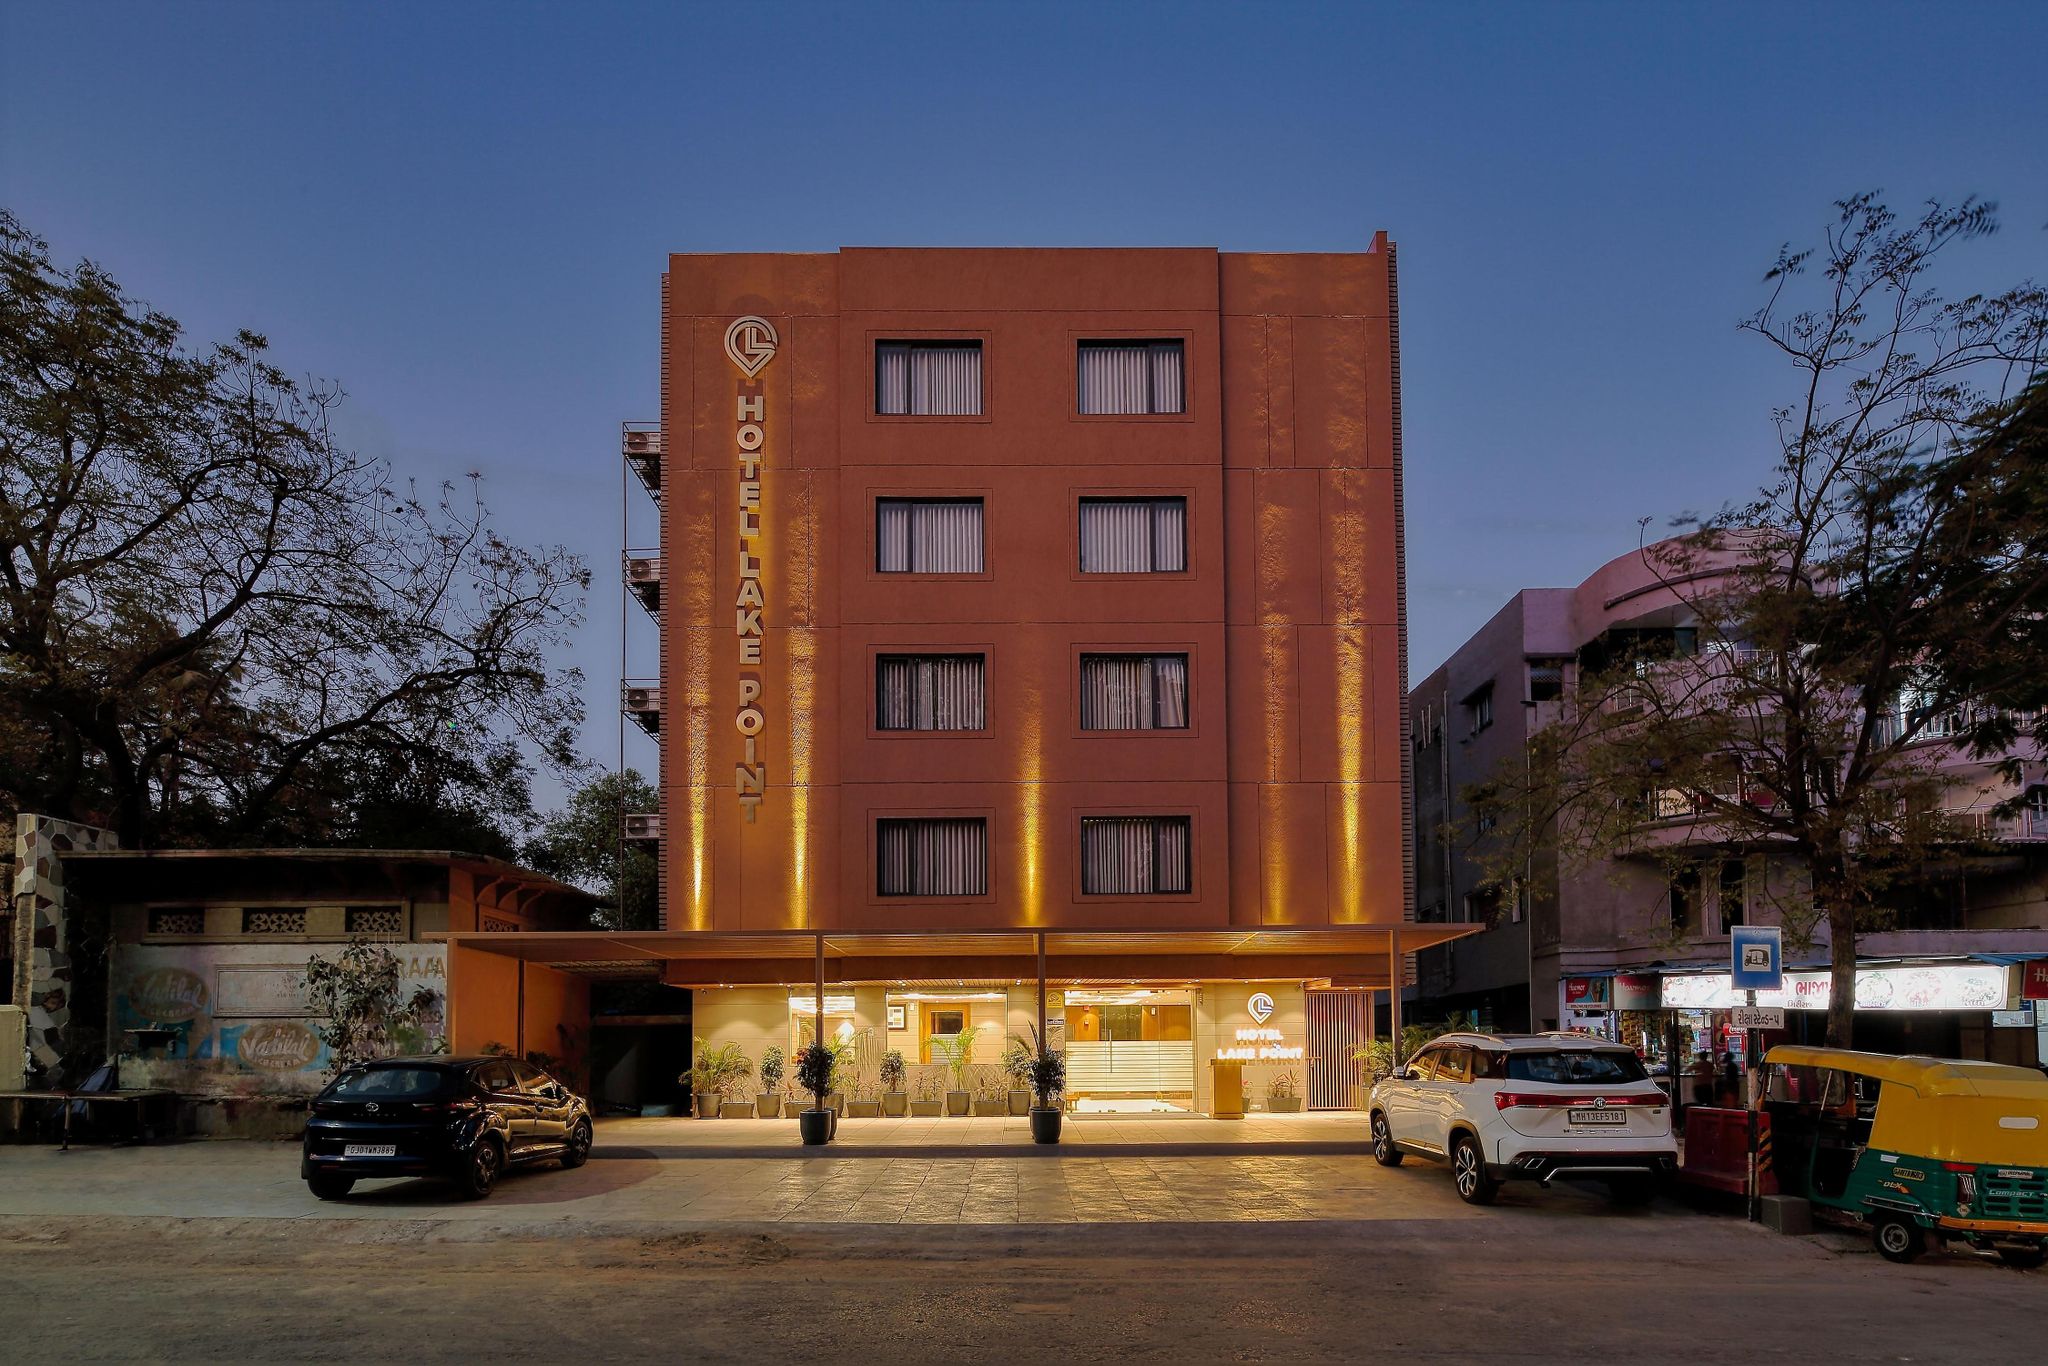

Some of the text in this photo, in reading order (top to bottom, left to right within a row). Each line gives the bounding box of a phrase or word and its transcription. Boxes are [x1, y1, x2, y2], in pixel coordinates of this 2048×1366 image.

[735, 395, 765, 824] HOTEL LAKE POINT
[1236, 1029, 1284, 1041] HOTEL
[1217, 1047, 1304, 1059] LAKE POINT
[1576, 1112, 1624, 1121] MH13EF5181
